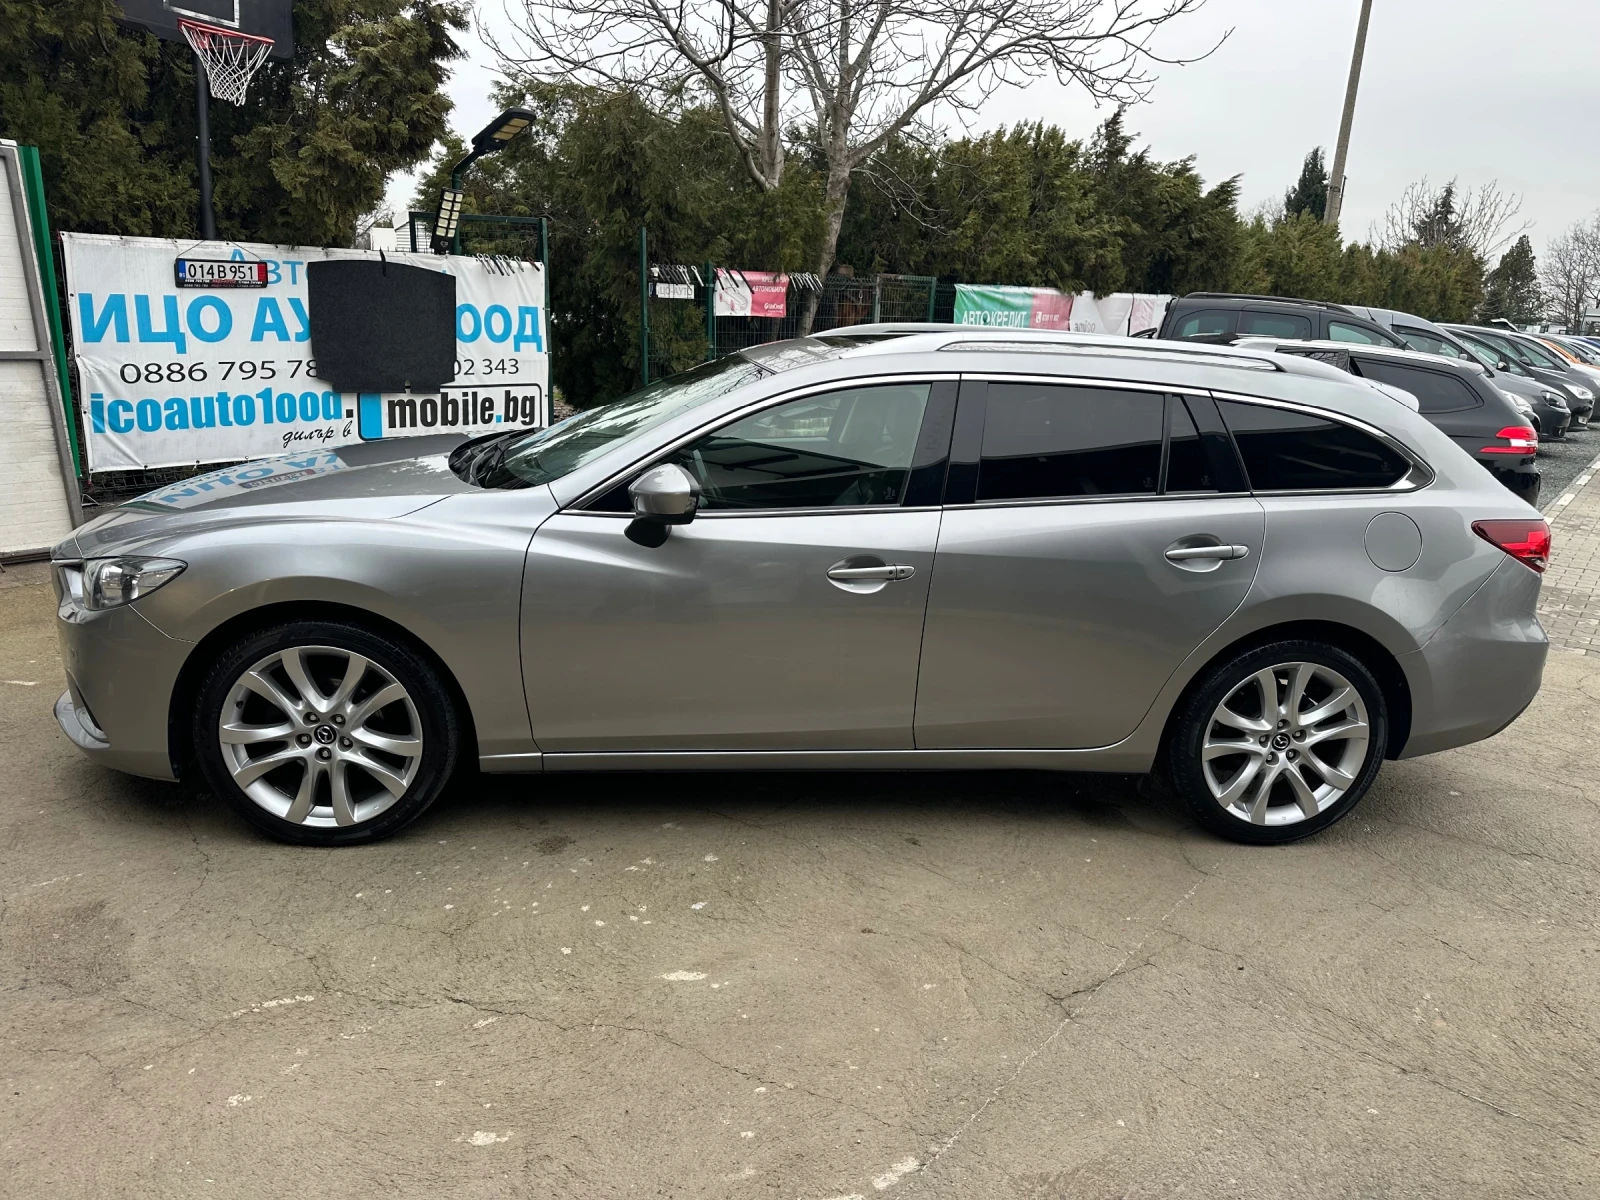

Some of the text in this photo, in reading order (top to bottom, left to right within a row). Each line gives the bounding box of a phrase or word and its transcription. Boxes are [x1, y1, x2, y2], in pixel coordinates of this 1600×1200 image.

[188, 264, 254, 280] 014 B 951
[78, 293, 543, 355] ИЦО АУ ООД
[962, 310, 1027, 327] АВТОКРЕДИТ
[119, 358, 519, 384] 0886 795 78 02 343
[387, 390, 536, 429] mobile.bg
[282, 420, 353, 448] дилър в
